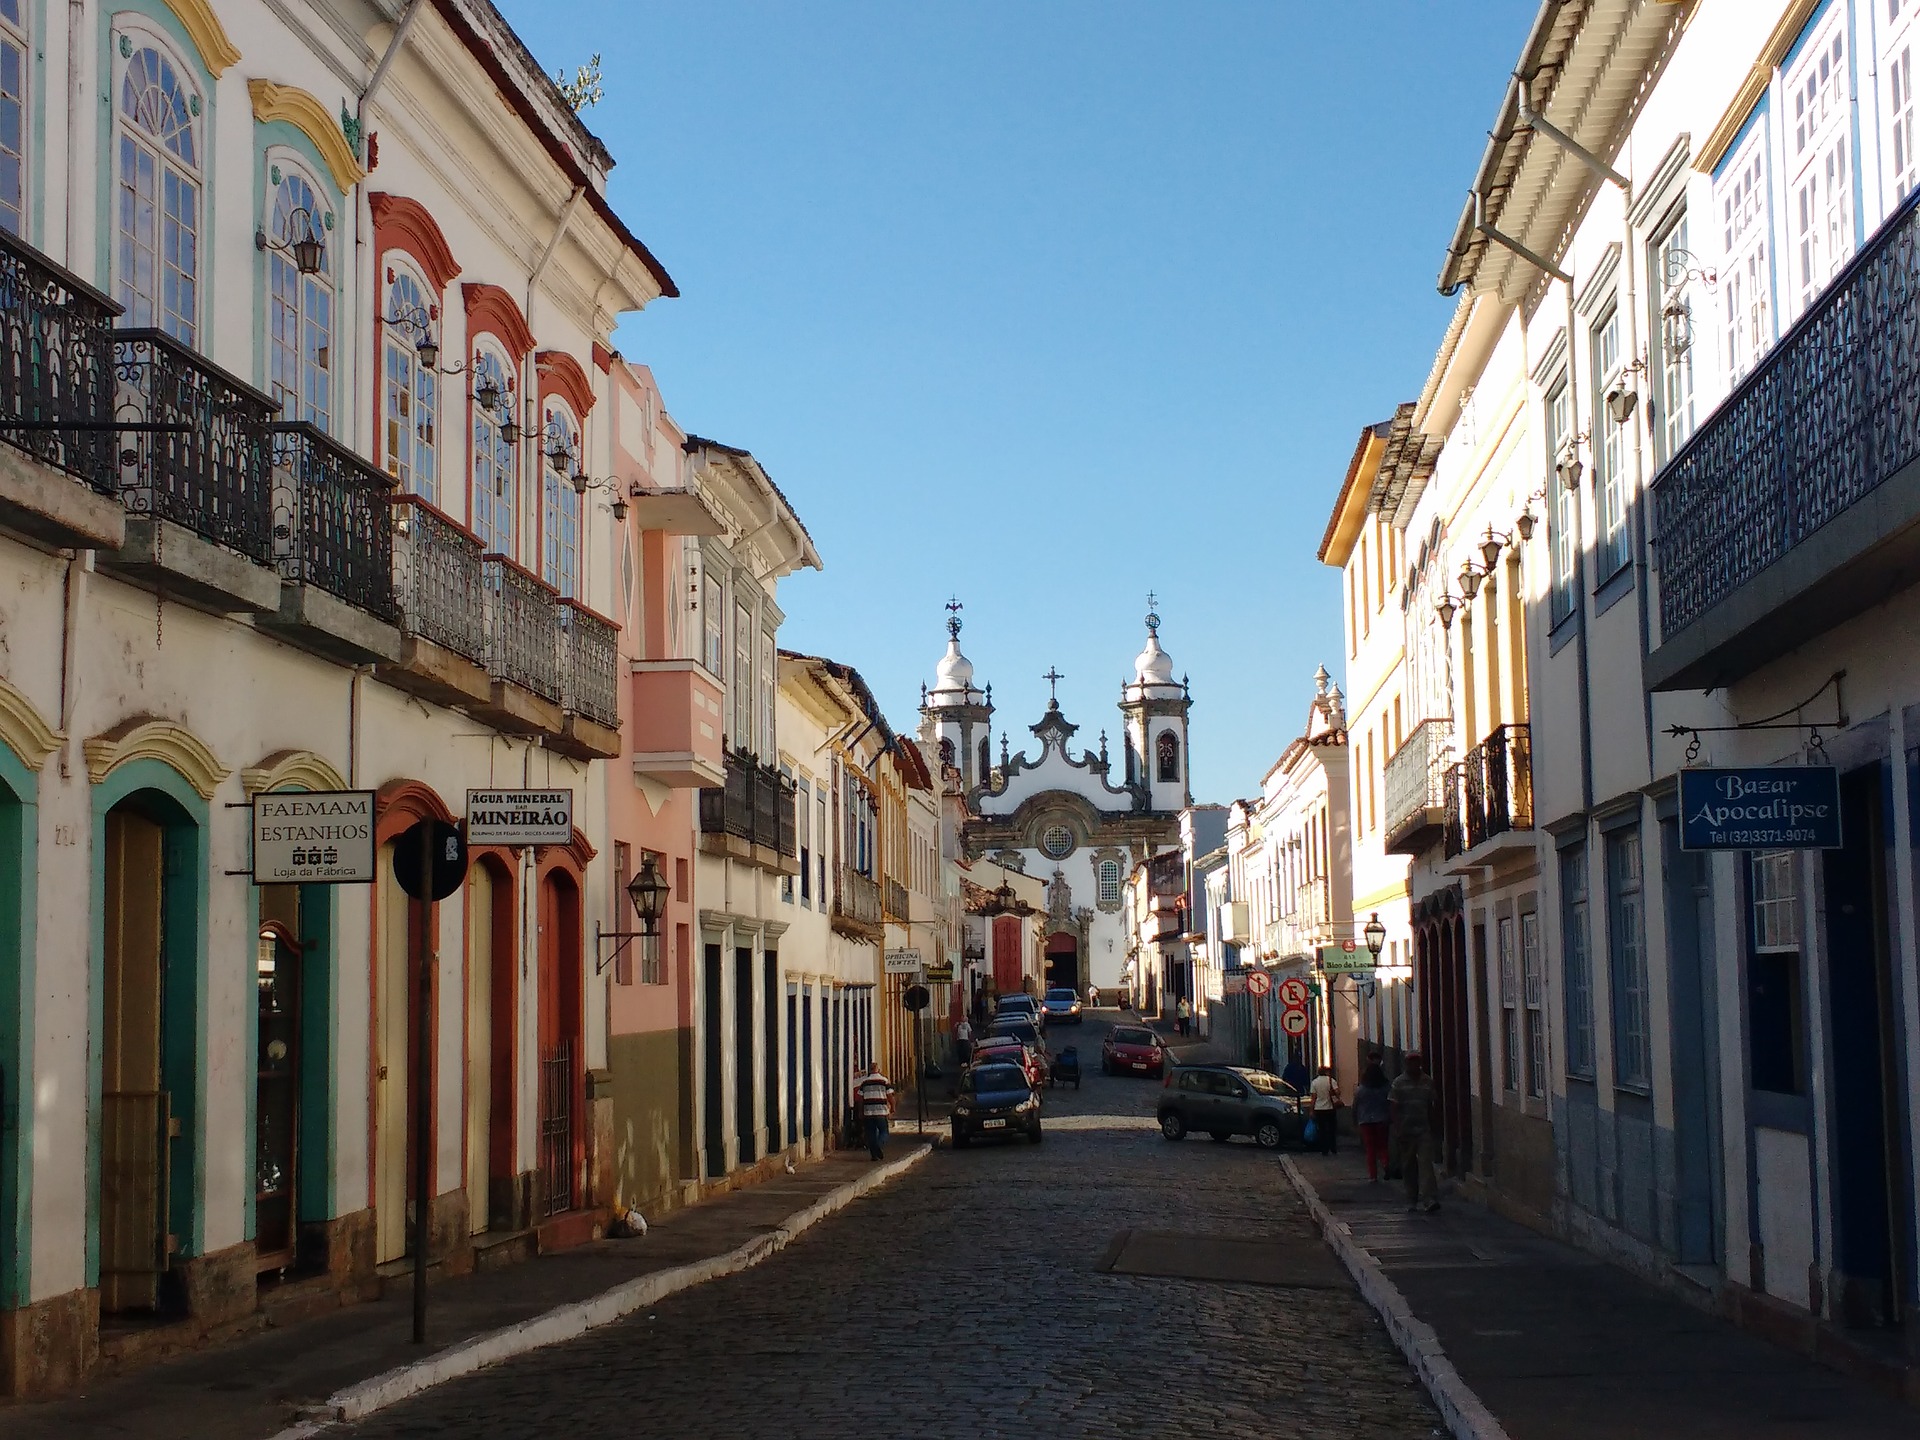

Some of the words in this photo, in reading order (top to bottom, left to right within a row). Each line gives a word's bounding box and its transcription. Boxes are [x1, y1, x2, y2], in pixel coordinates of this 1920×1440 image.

[1715, 775, 1798, 800] Bazar
[471, 791, 504, 804] ÁGUA
[506, 794, 564, 804] MINERAL
[261, 801, 368, 817] FAEMAM
[470, 807, 568, 826] MINEIRÃO
[1688, 799, 1829, 827] Apocalipse
[260, 824, 369, 842] ESTANHOS
[1709, 831, 1727, 844] Tel
[274, 867, 297, 879] Loja
[299, 867, 313, 878] da
